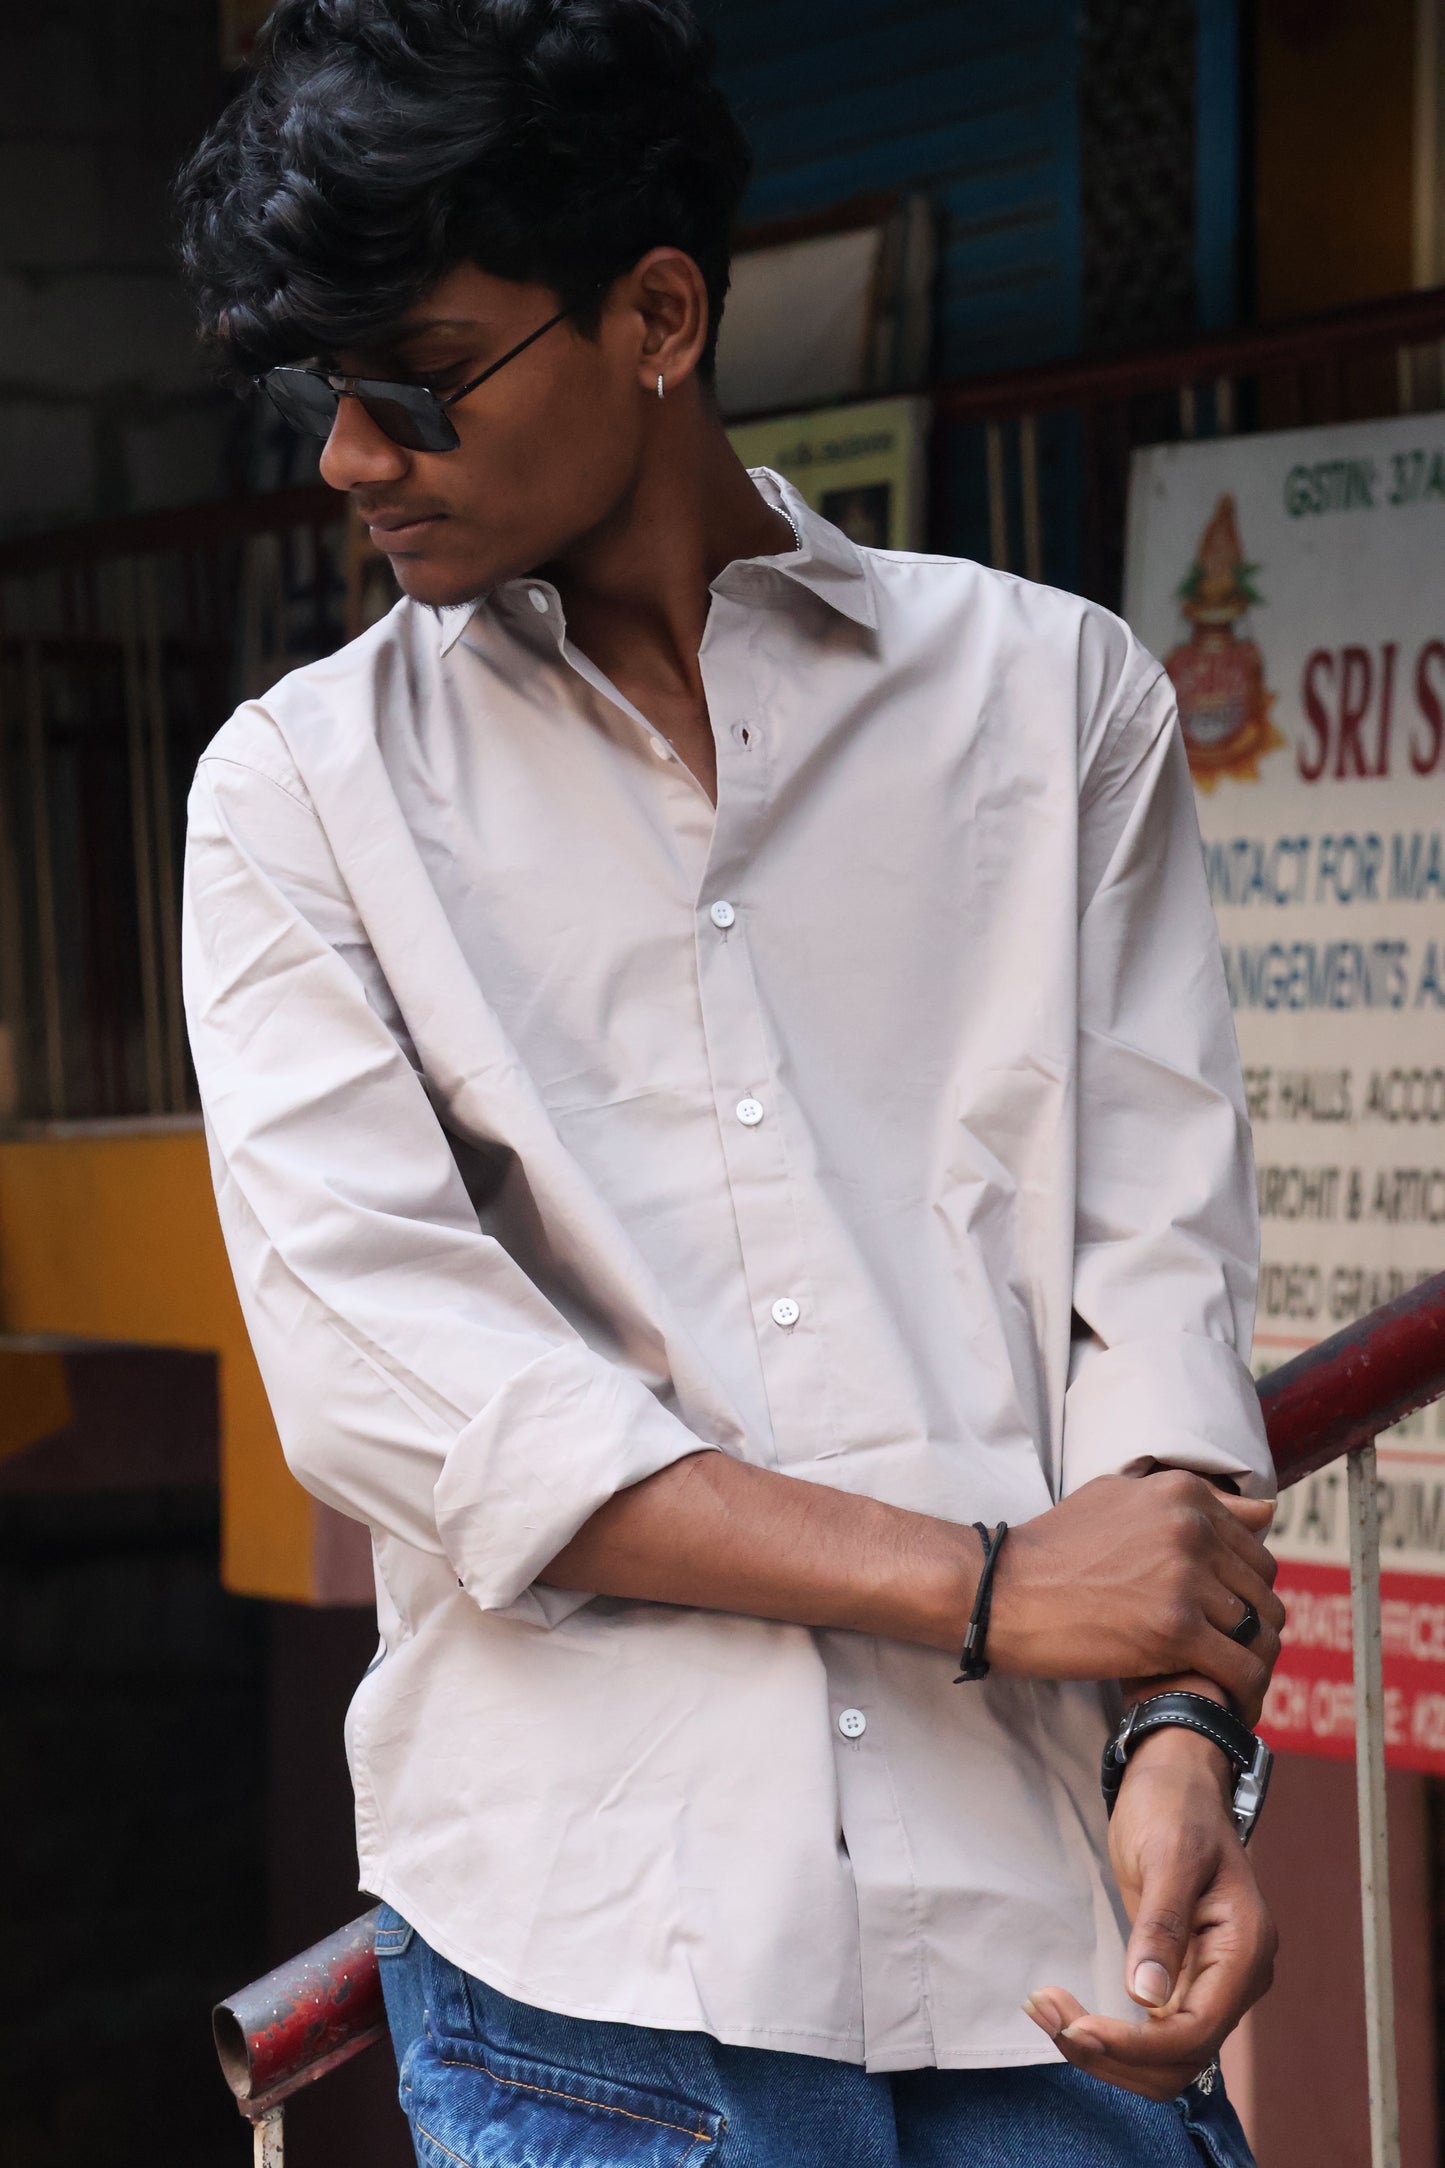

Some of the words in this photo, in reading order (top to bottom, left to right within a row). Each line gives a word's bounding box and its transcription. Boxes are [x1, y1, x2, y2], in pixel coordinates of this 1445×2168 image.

[1297, 641, 1397, 780] SRI
[1202, 836, 1310, 906] NTACT
[1316, 834, 1382, 904] FOR
[1414, 938, 1445, 1008] A
[1311, 1679, 1403, 1746] OFE
